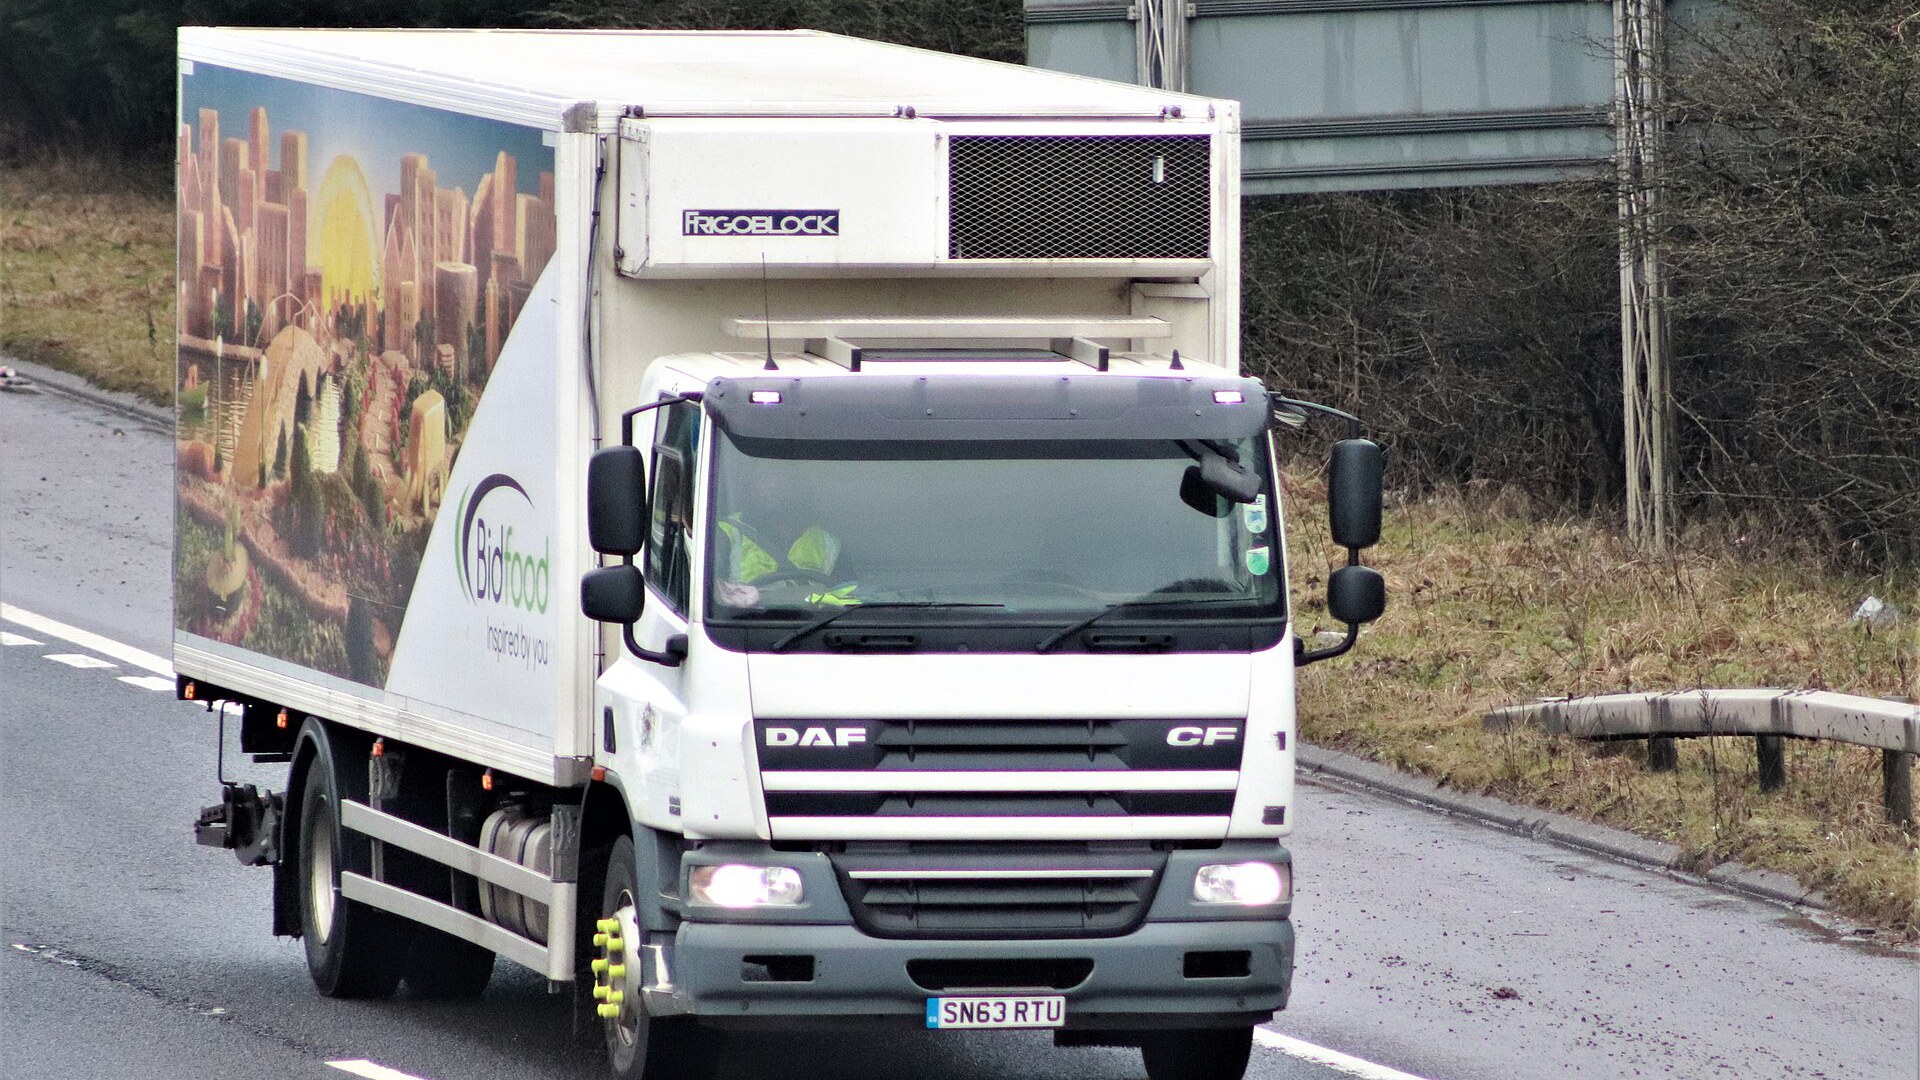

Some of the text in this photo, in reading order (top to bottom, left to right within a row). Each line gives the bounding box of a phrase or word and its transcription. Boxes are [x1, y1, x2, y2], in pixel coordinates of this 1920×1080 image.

[685, 211, 839, 235] FRIGOBLOCK
[476, 517, 550, 615] Bidfood
[486, 615, 549, 672] Inspired by you
[765, 727, 866, 747] DAF
[1166, 726, 1238, 747] CF
[943, 1000, 1061, 1024] SN63 RTU
